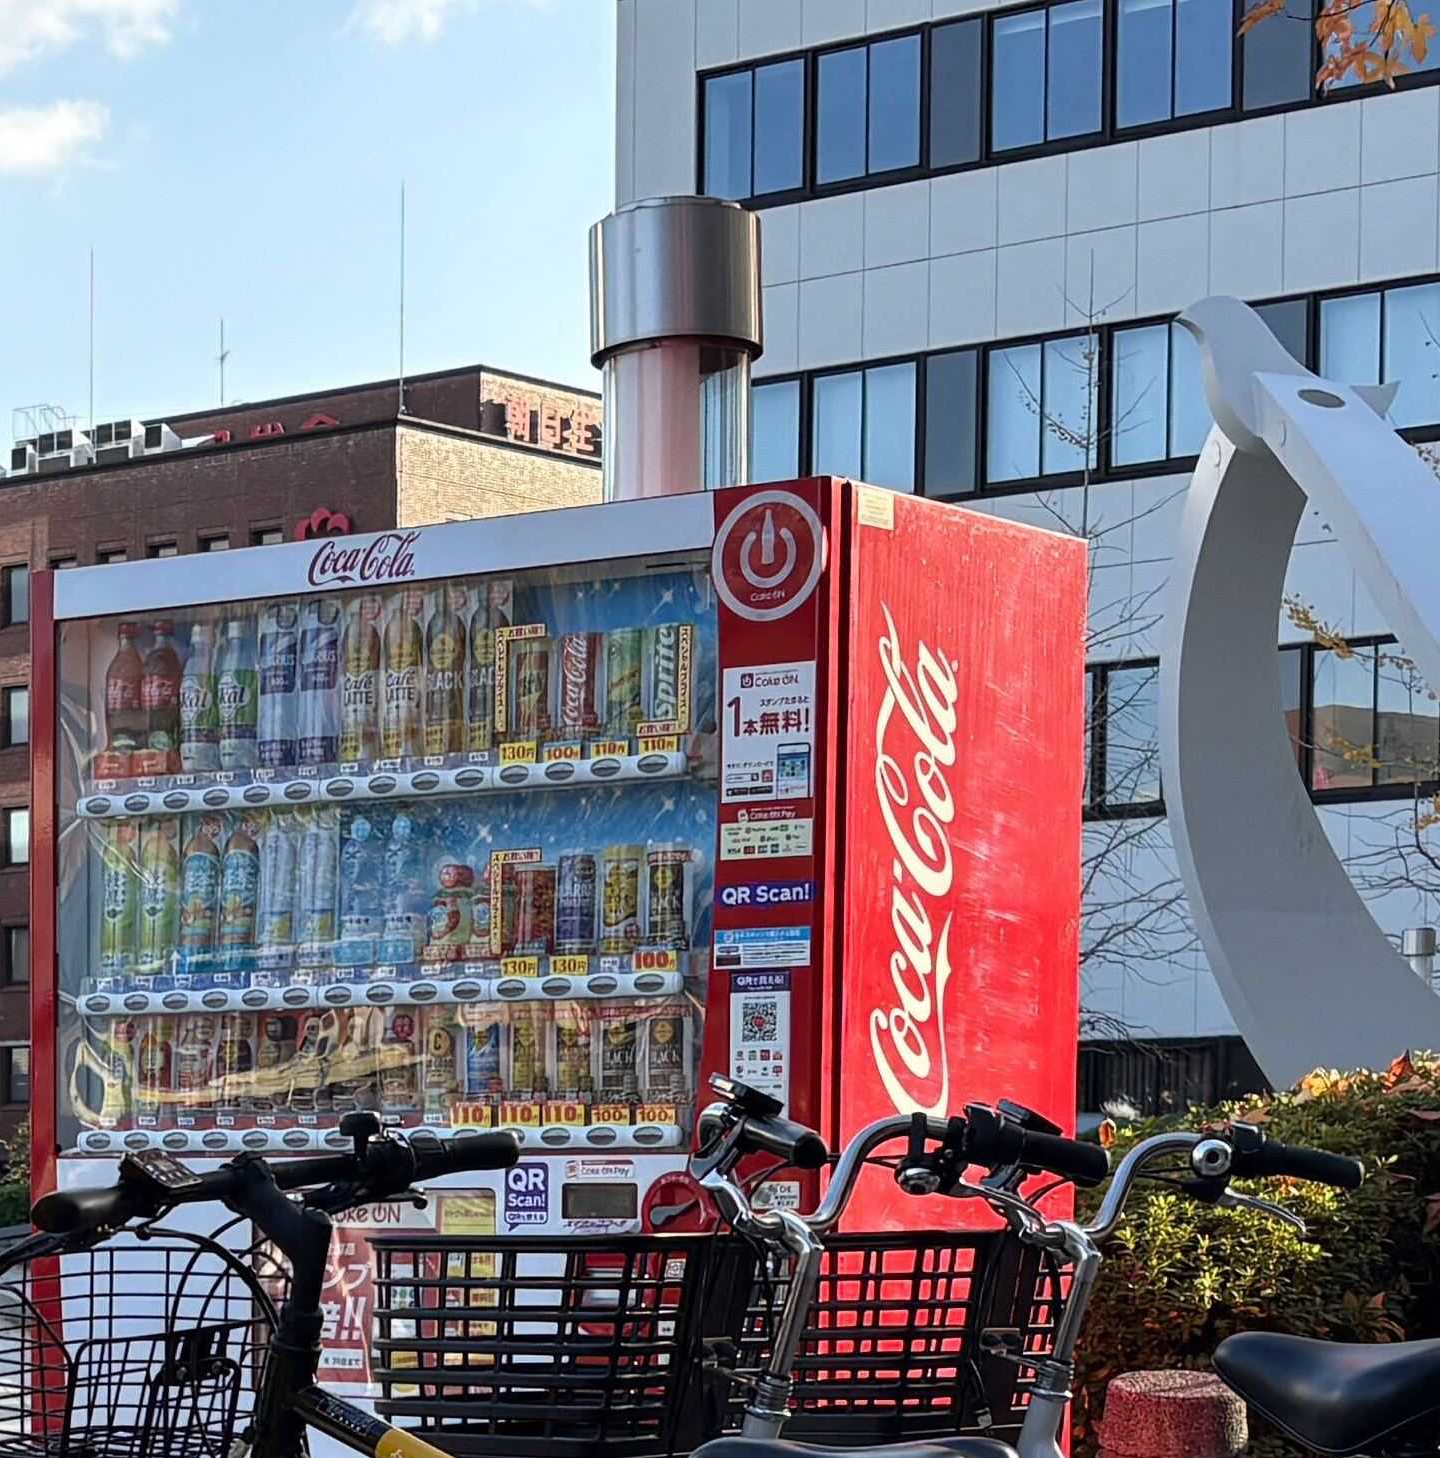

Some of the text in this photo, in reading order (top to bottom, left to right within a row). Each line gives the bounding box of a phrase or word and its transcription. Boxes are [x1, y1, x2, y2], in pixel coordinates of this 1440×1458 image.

[307, 530, 420, 586] Coca-Cola
[655, 625, 675, 719] Sprite
[869, 600, 959, 1118] Coca-Cola
[723, 883, 810, 906] QR Scan!
[508, 1167, 545, 1192] QR
[333, 1203, 368, 1223] oke
[508, 1193, 546, 1208] Scan!
